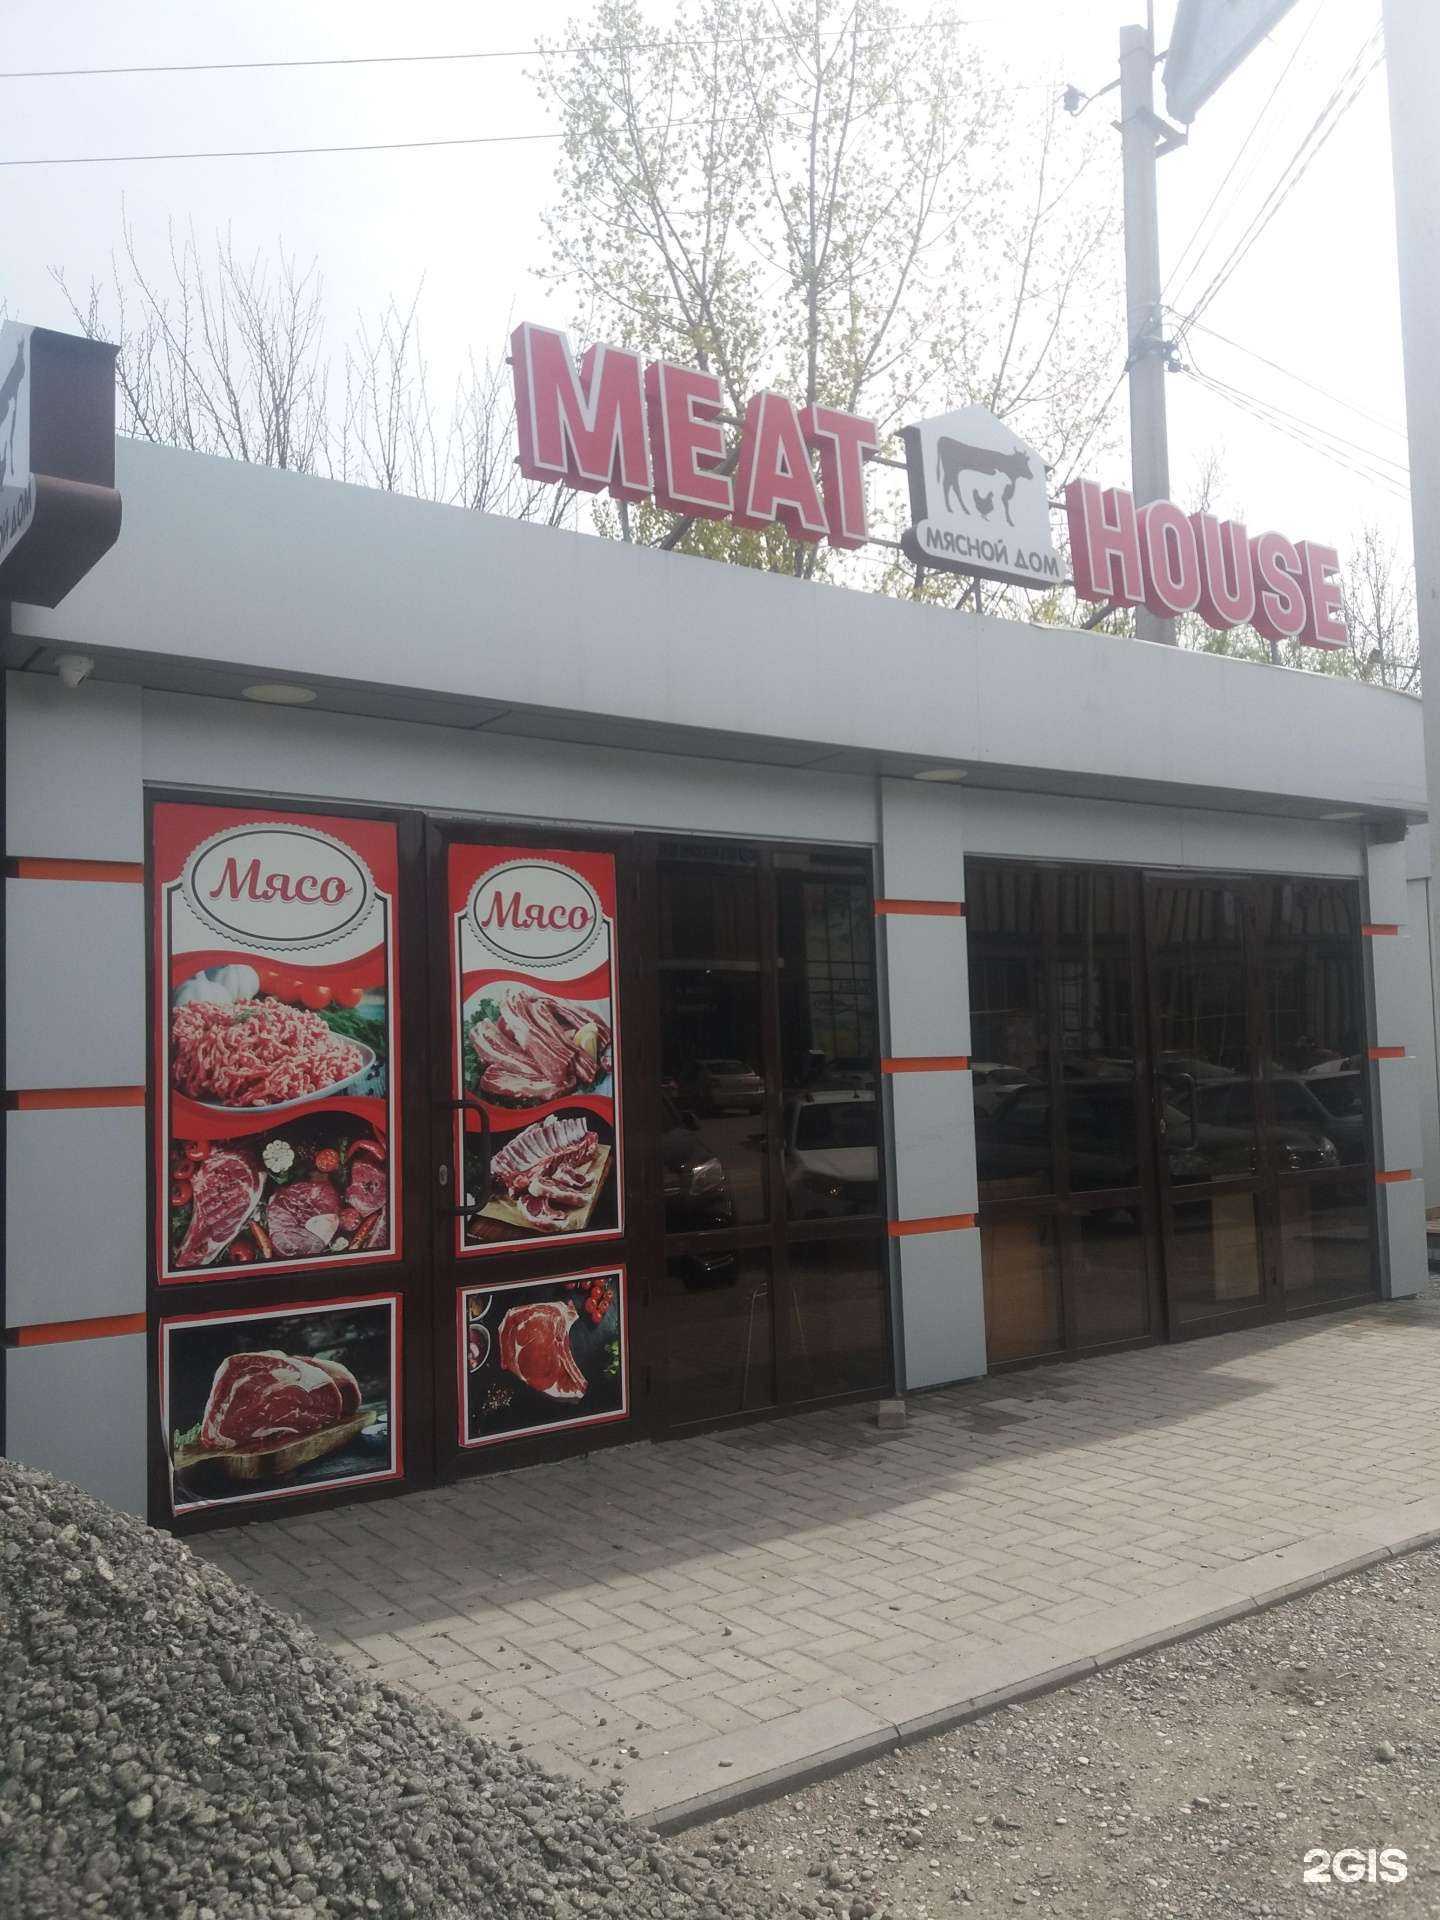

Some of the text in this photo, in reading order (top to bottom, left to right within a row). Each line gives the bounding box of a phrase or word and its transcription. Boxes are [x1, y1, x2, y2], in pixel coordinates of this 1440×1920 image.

[511, 321, 1348, 650] MEAT HOUSE
[926, 526, 1060, 577] МЯСНОЙ ДОМ
[210, 857, 352, 904] Мясо
[481, 890, 593, 931] Мясо
